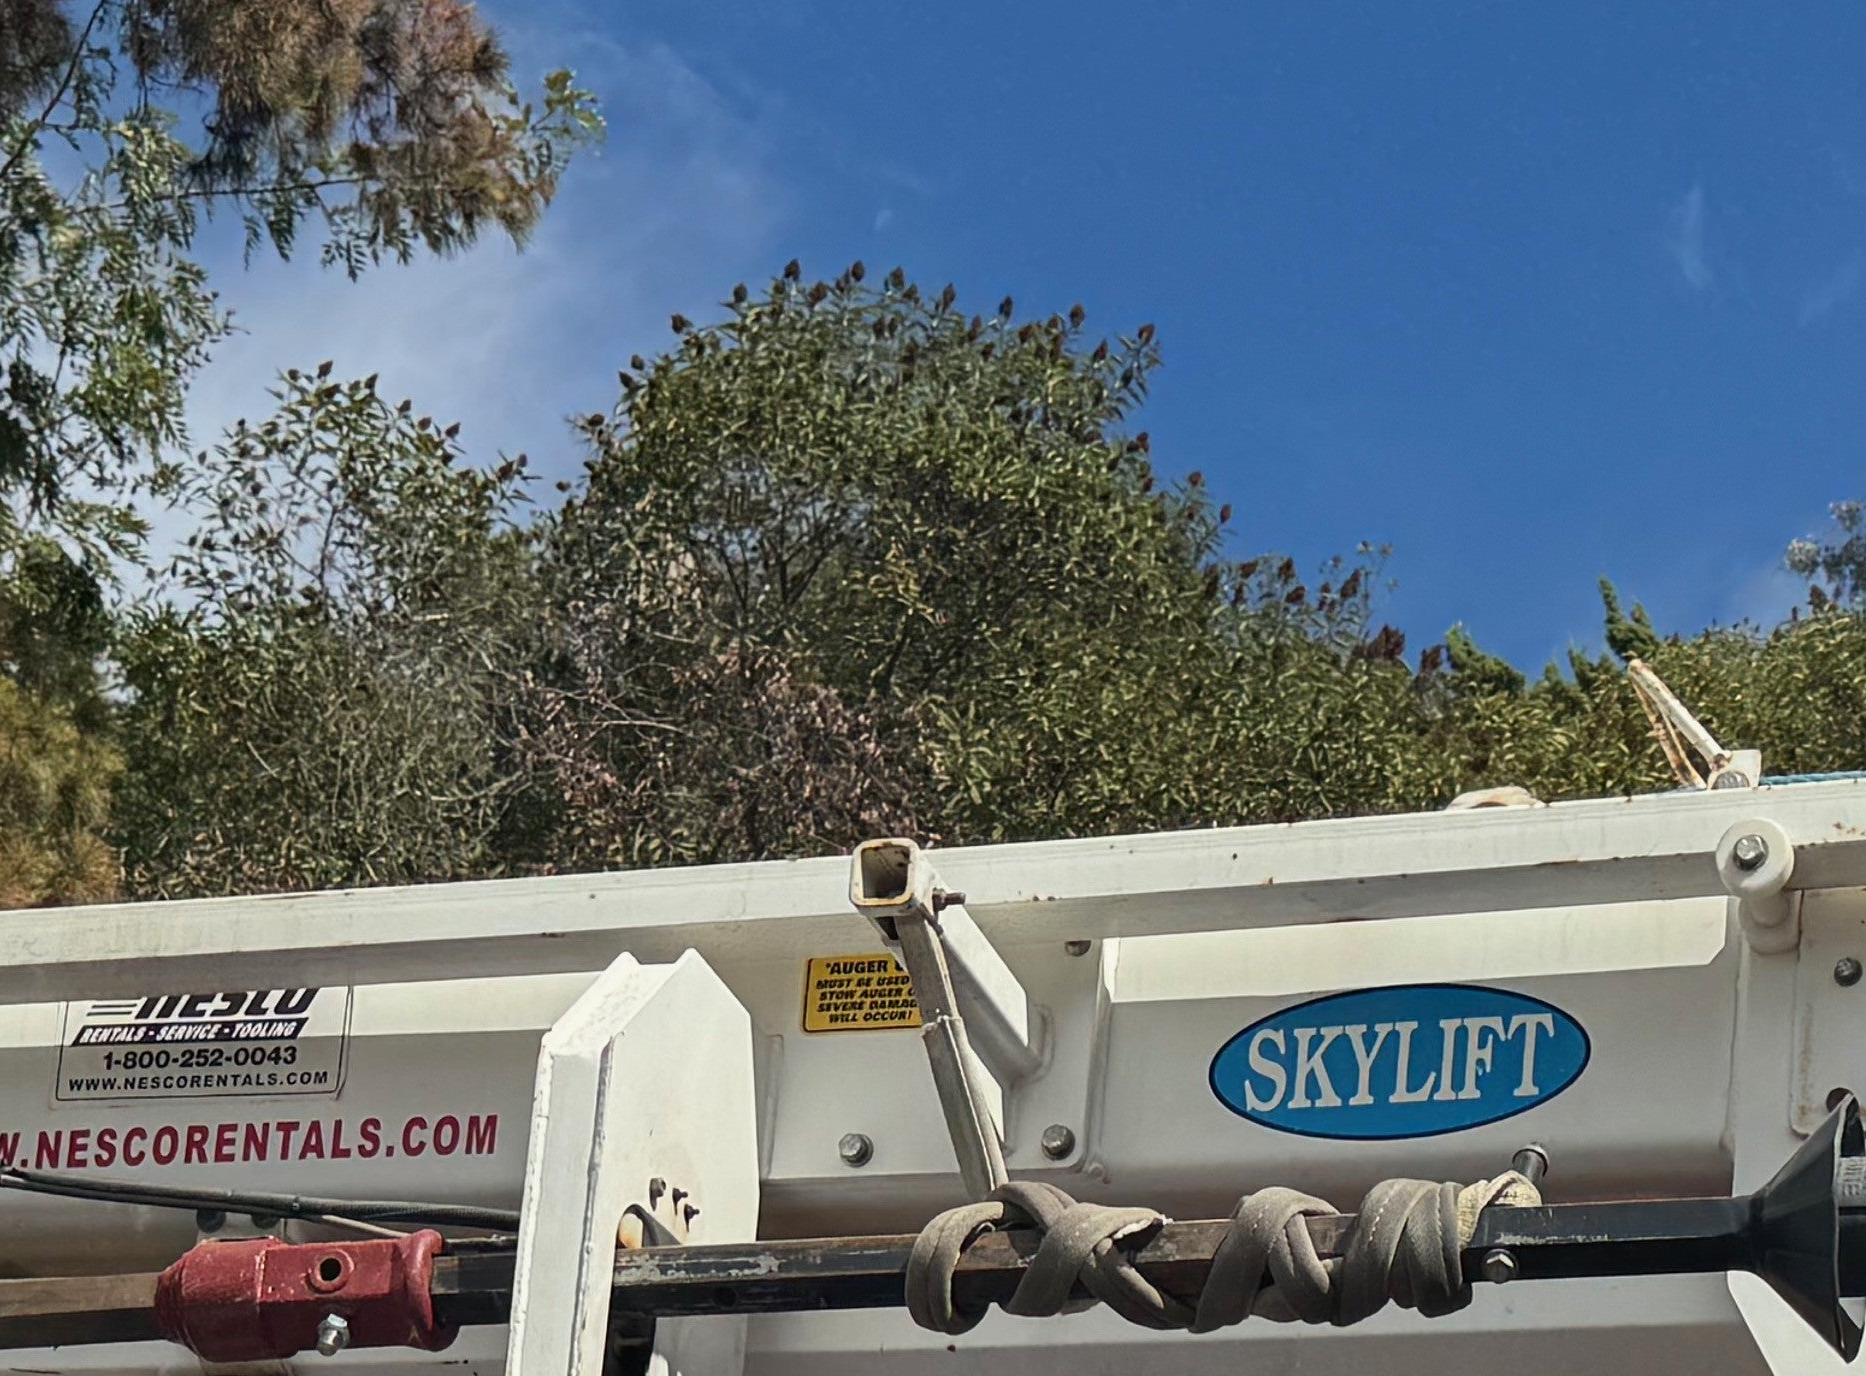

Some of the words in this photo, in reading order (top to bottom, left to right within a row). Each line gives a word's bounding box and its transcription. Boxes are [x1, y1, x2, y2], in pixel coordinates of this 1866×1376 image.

[858, 987, 904, 999] AUGER
[817, 1001, 865, 1013] SEVERE
[868, 999, 917, 1010] DAMAG
[828, 1013, 858, 1023] WILL
[81, 1025, 145, 1044] RENTALS
[155, 1023, 223, 1041] SERVICE
[231, 1020, 297, 1039] TOOLING
[102, 1046, 298, 1071] 1-800-252-0043
[1244, 1012, 1555, 1112] SKYLIFT
[68, 1071, 328, 1092] WWW.NESCORENTALS.COM
